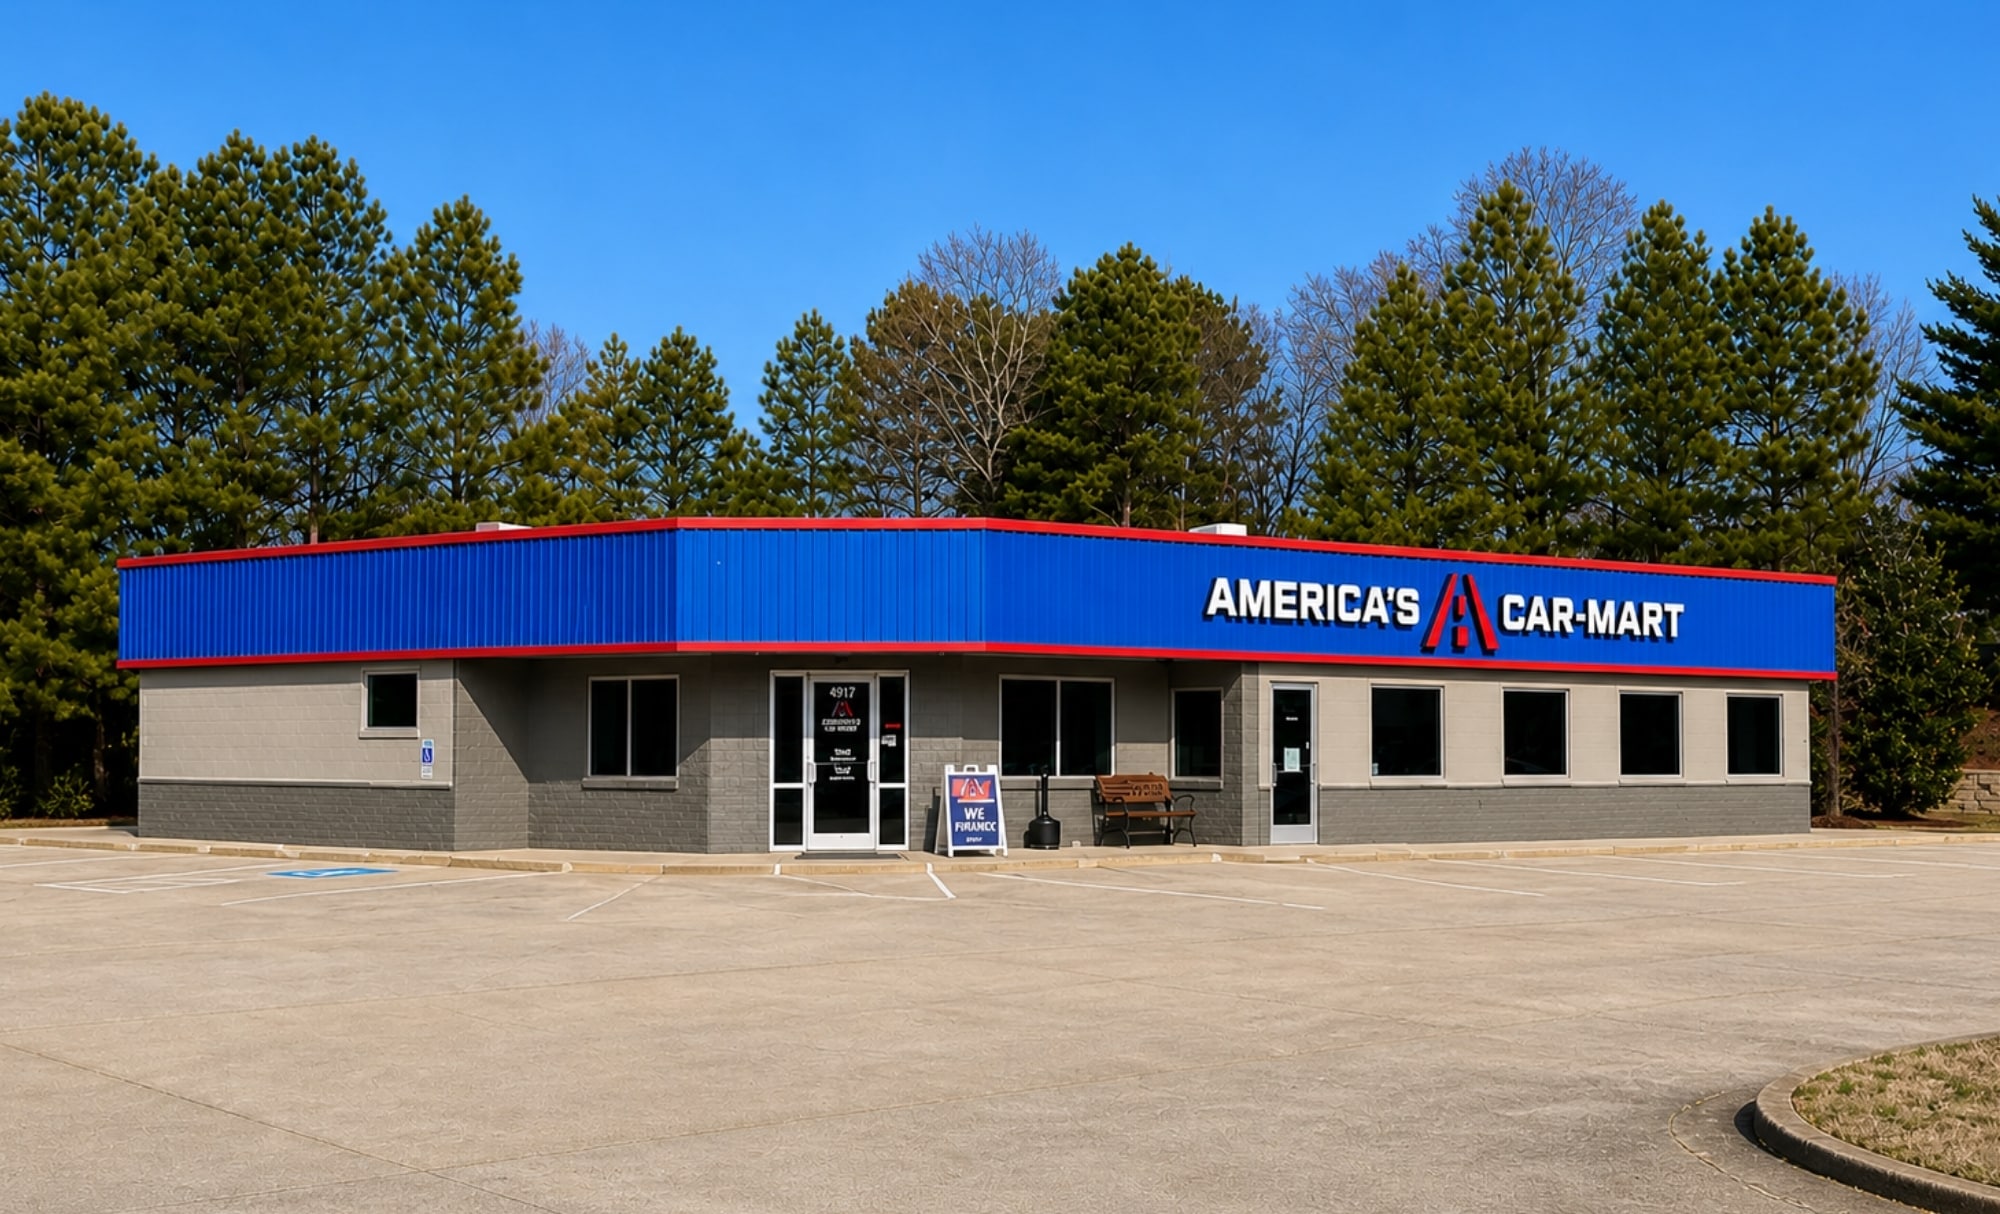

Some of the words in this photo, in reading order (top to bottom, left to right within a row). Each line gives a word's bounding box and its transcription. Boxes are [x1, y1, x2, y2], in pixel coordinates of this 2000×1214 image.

[1205, 577, 1420, 625] AMERICA'S
[1502, 594, 1685, 638] CAR-MART
[829, 687, 856, 698] 4917
[964, 807, 985, 820] WE
